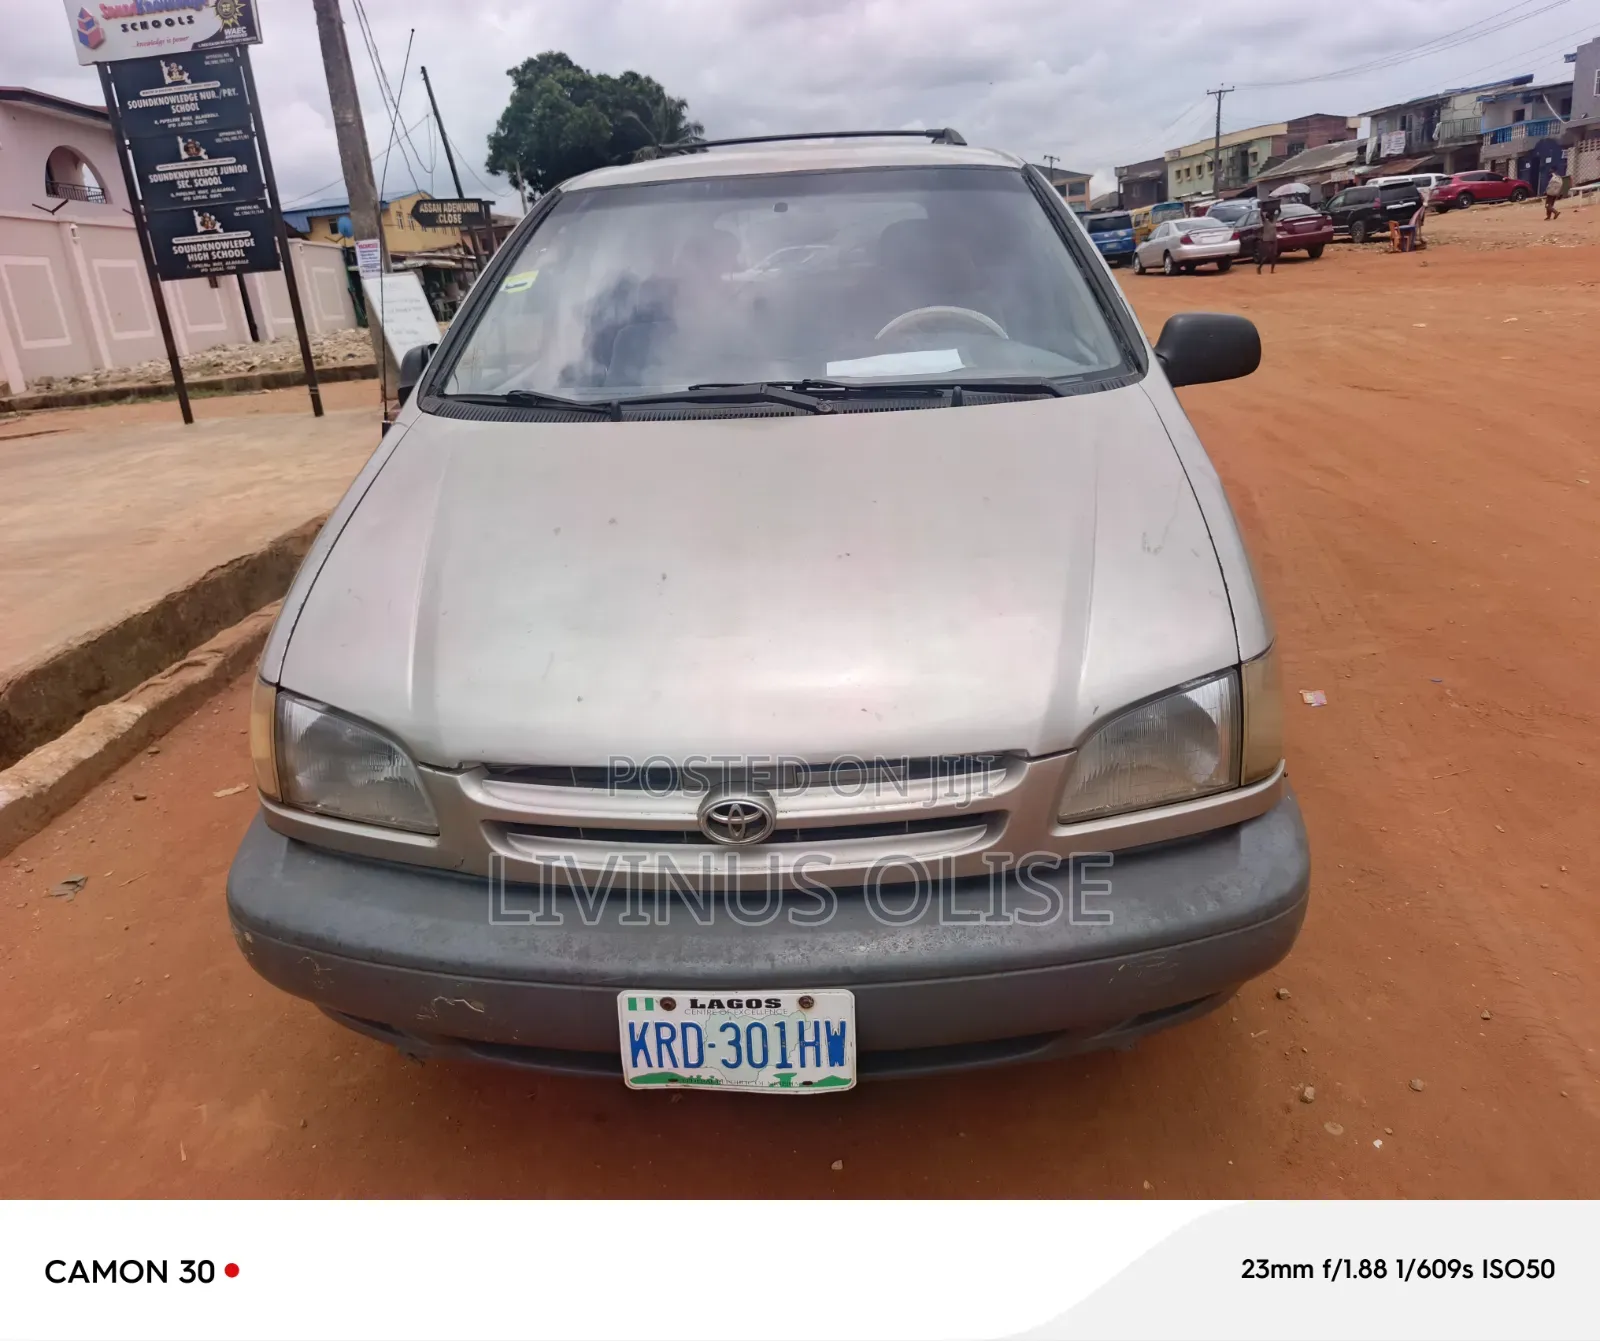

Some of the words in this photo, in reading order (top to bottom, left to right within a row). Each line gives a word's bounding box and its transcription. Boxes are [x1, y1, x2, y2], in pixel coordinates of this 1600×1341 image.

[121, 15, 195, 33] SCHOOLS
[224, 26, 247, 36] WAEC
[127, 92, 199, 110] SOUNDKNOWLEDGE
[199, 87, 239, 100] NUR./PRY.
[171, 102, 200, 114] SCHOOL
[148, 166, 219, 183] SOUNDKNOWLEDGE
[220, 164, 248, 176] JUNIOR
[176, 179, 192, 189] SEC.
[193, 176, 222, 188] SCHOOL
[438, 213, 462, 224] CLOSE
[172, 238, 255, 255] SOUNDKNOWLEDGE
[187, 251, 210, 262] HIGH
[211, 248, 245, 260] SCHOOL
[690, 998, 782, 1009] LAGOS
[628, 1020, 847, 1070] KRD-301HW
